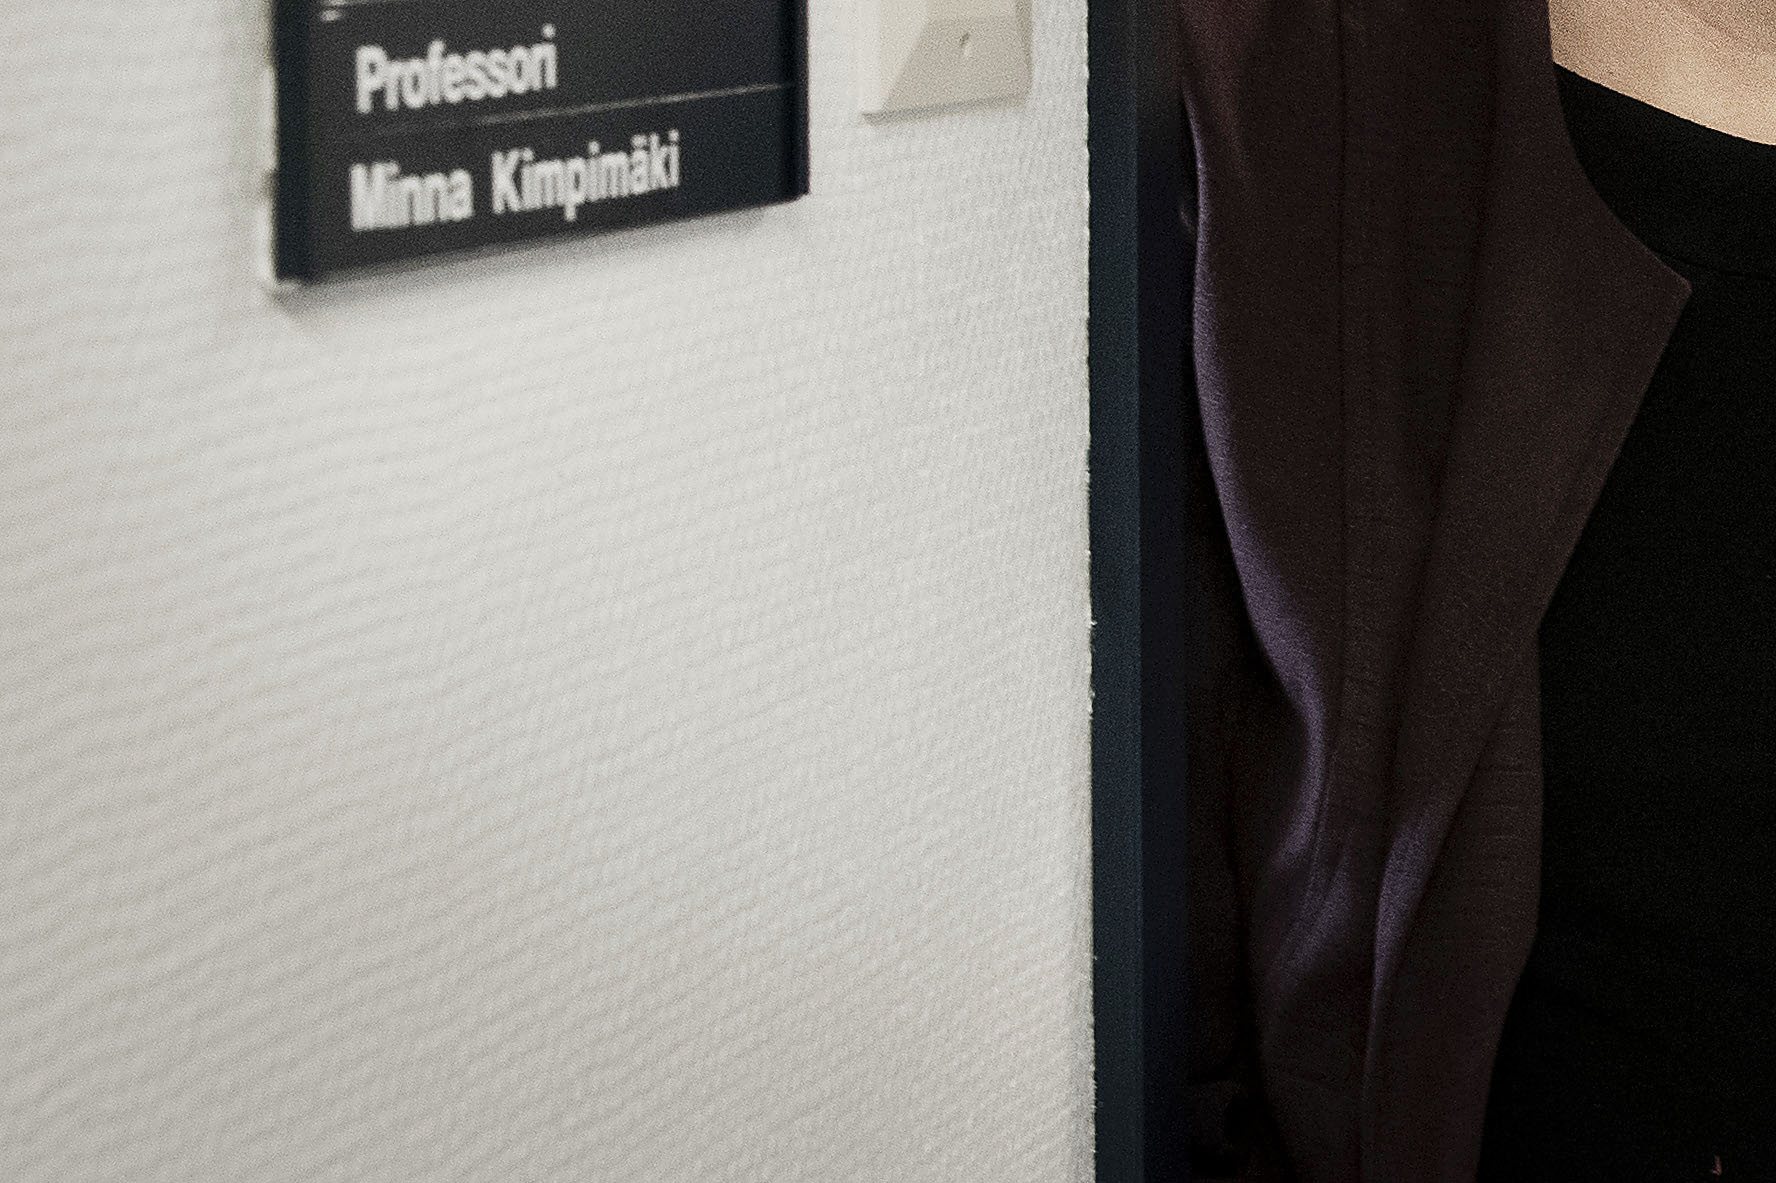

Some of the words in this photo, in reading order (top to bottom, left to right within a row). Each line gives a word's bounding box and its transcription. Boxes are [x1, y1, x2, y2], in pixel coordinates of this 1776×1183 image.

[355, 23, 558, 114] Professori
[349, 160, 475, 234] Minna
[491, 128, 681, 223] Kimpimäki
